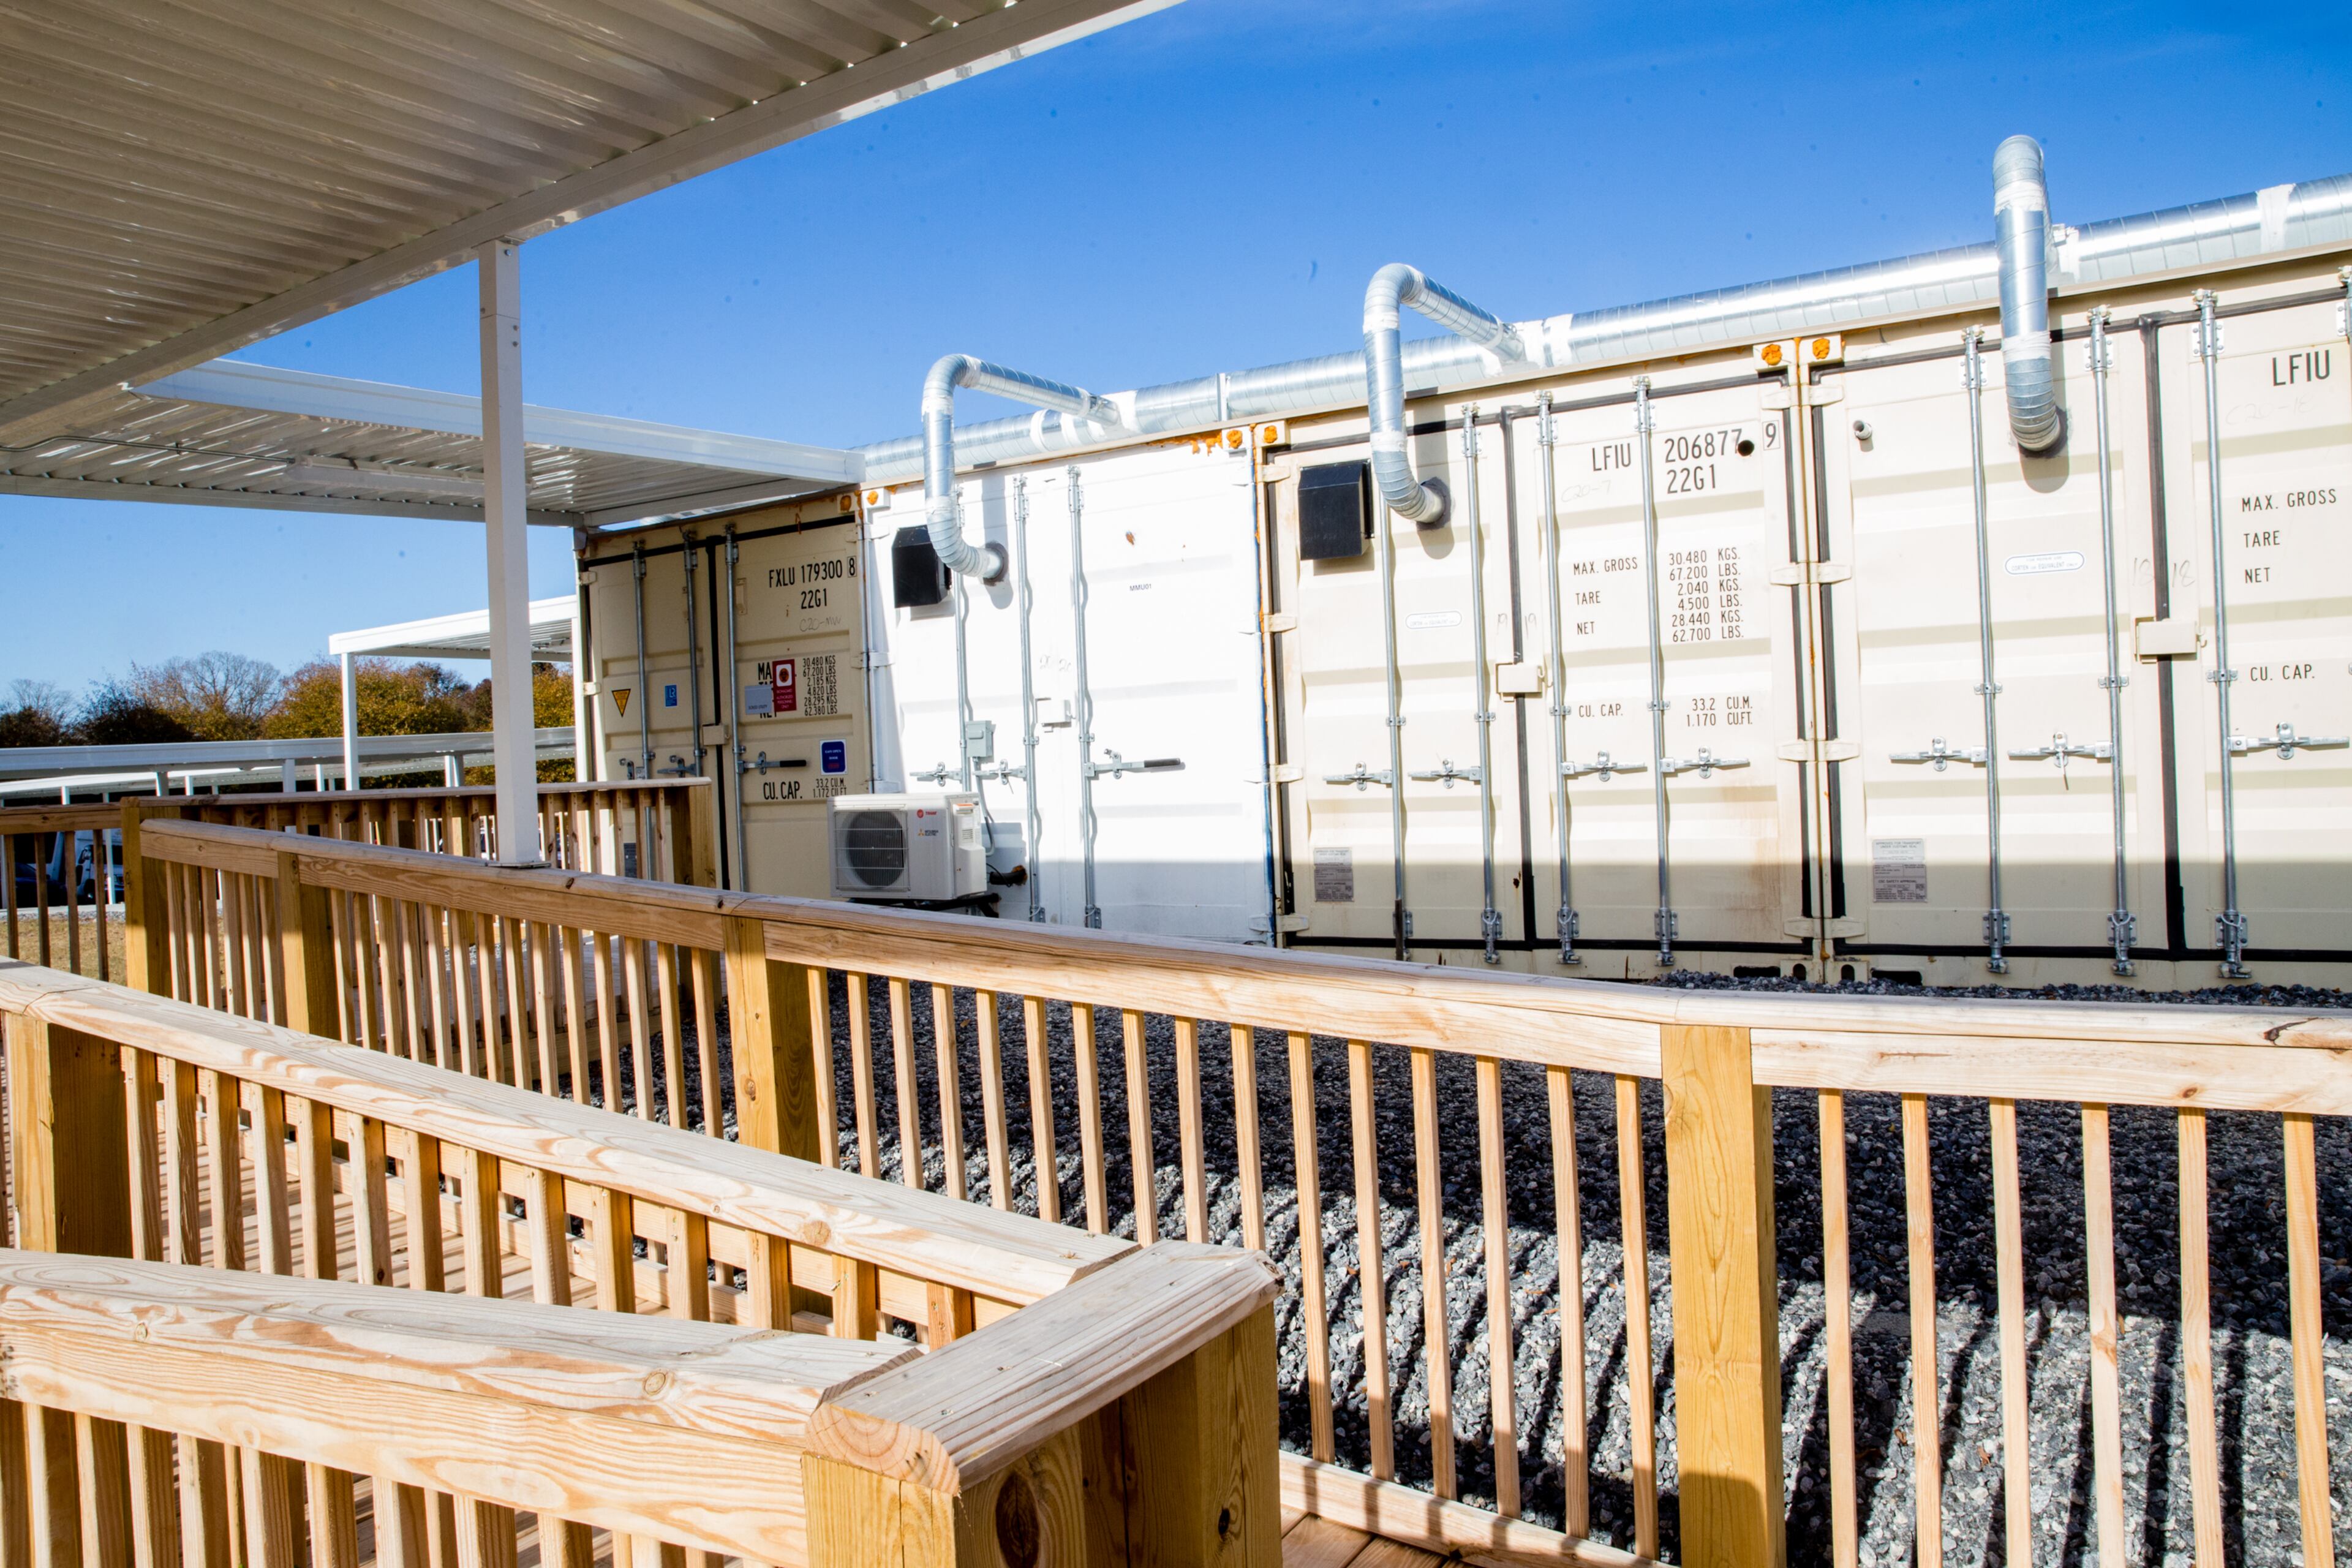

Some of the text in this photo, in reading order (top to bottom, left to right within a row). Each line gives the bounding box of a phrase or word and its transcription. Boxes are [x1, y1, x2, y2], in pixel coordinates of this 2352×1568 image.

[2272, 350, 2330, 386] LFIU
[1592, 423, 1776, 472] LFIU 206877 9
[1667, 464, 1716, 494] 22G1
[2242, 489, 2336, 512] MAX. GROSS
[2244, 530, 2280, 548] TARE
[1668, 547, 1741, 566] 30.480 KGS.
[769, 558, 855, 588] FXLU 179300 8
[1574, 557, 1638, 576] MAX. GROSS
[1669, 562, 1741, 581] 67.200 LBS.
[2245, 567, 2271, 584] NET
[1678, 578, 1742, 596] 2.040 KGS.
[801, 588, 827, 609] 22G1
[1576, 591, 1601, 605] TARE
[1678, 594, 1743, 611] 4.500 LBS.
[1672, 609, 1744, 627] 28.440 KGS.
[1577, 622, 1595, 635] NET
[1672, 625, 1744, 643] 62.700 LBS.
[802, 655, 836, 667] 30.480 KGS
[758, 662, 772, 680] MA
[803, 665, 836, 677] 67.200 LBS
[2250, 664, 2315, 681] CU. CAP.
[807, 675, 837, 687] 2.185 KGS
[807, 685, 837, 696] 4.820 LBS
[804, 695, 837, 707] 28.295 KGS
[1692, 696, 1753, 711] 33.2 CU.M.
[805, 704, 837, 716] 62.380 LBS
[1578, 703, 1623, 718] CU. CAP.
[1687, 712, 1753, 727] 1.170 CU.FT.
[763, 781, 802, 800] CU. CAP.
[816, 778, 829, 788] 33.2
[813, 788, 829, 798] 1.172
